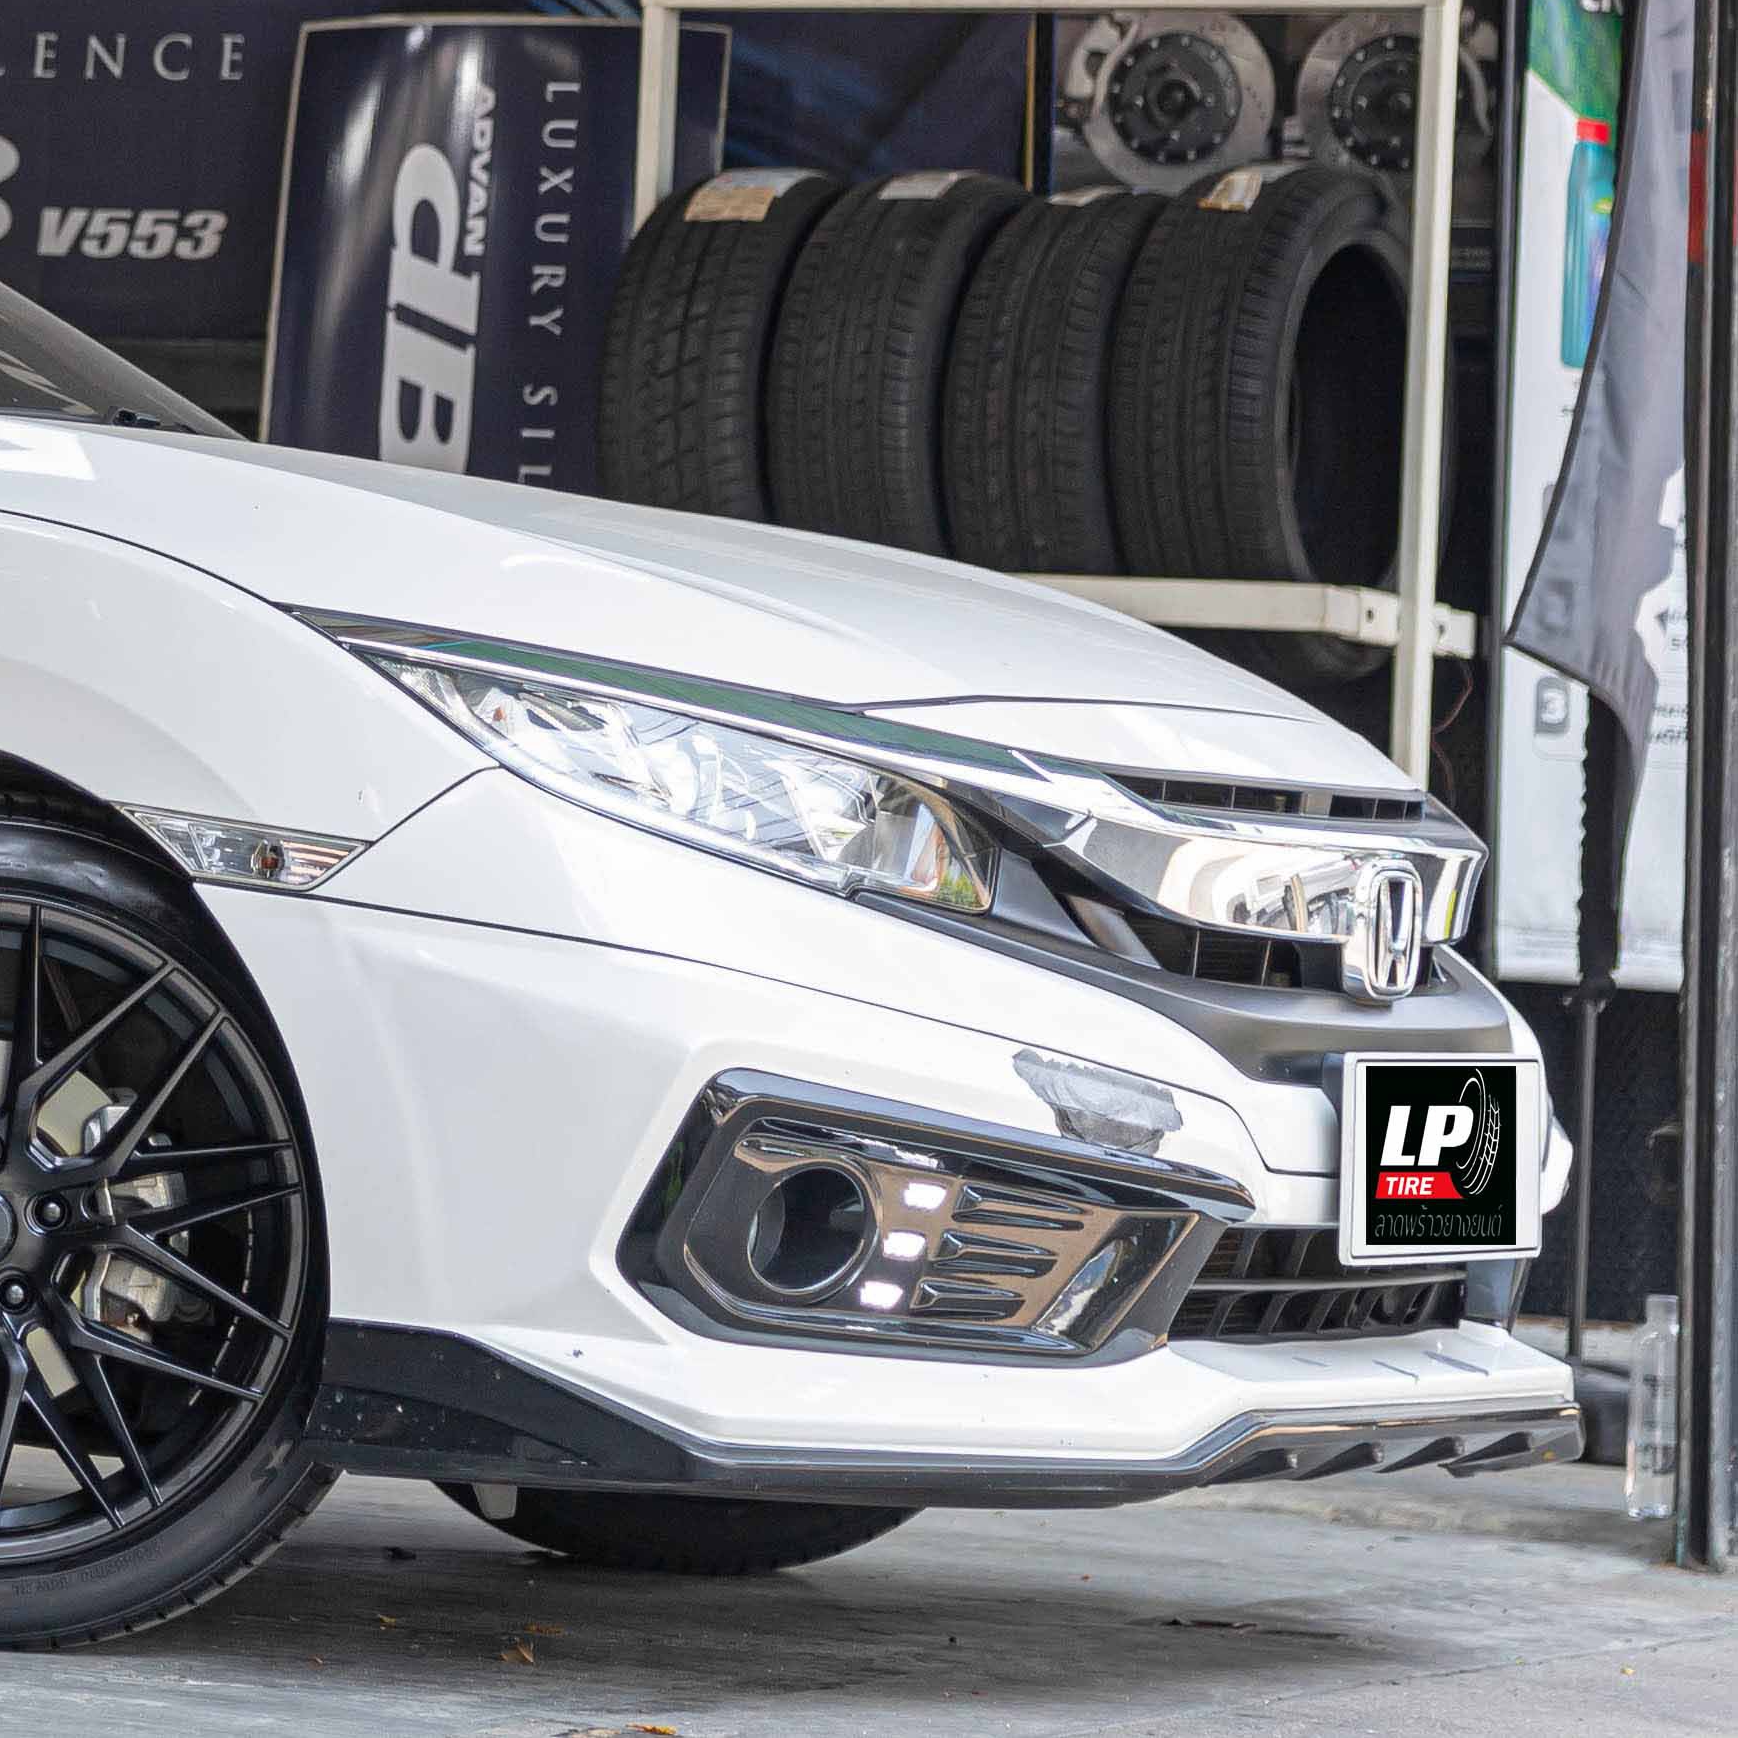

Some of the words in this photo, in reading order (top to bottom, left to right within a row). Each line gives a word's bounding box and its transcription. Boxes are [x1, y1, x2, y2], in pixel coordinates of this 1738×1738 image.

[36, 207, 229, 260] V553
[462, 82, 499, 258] ADVAN
[528, 79, 583, 337] LUXURY
